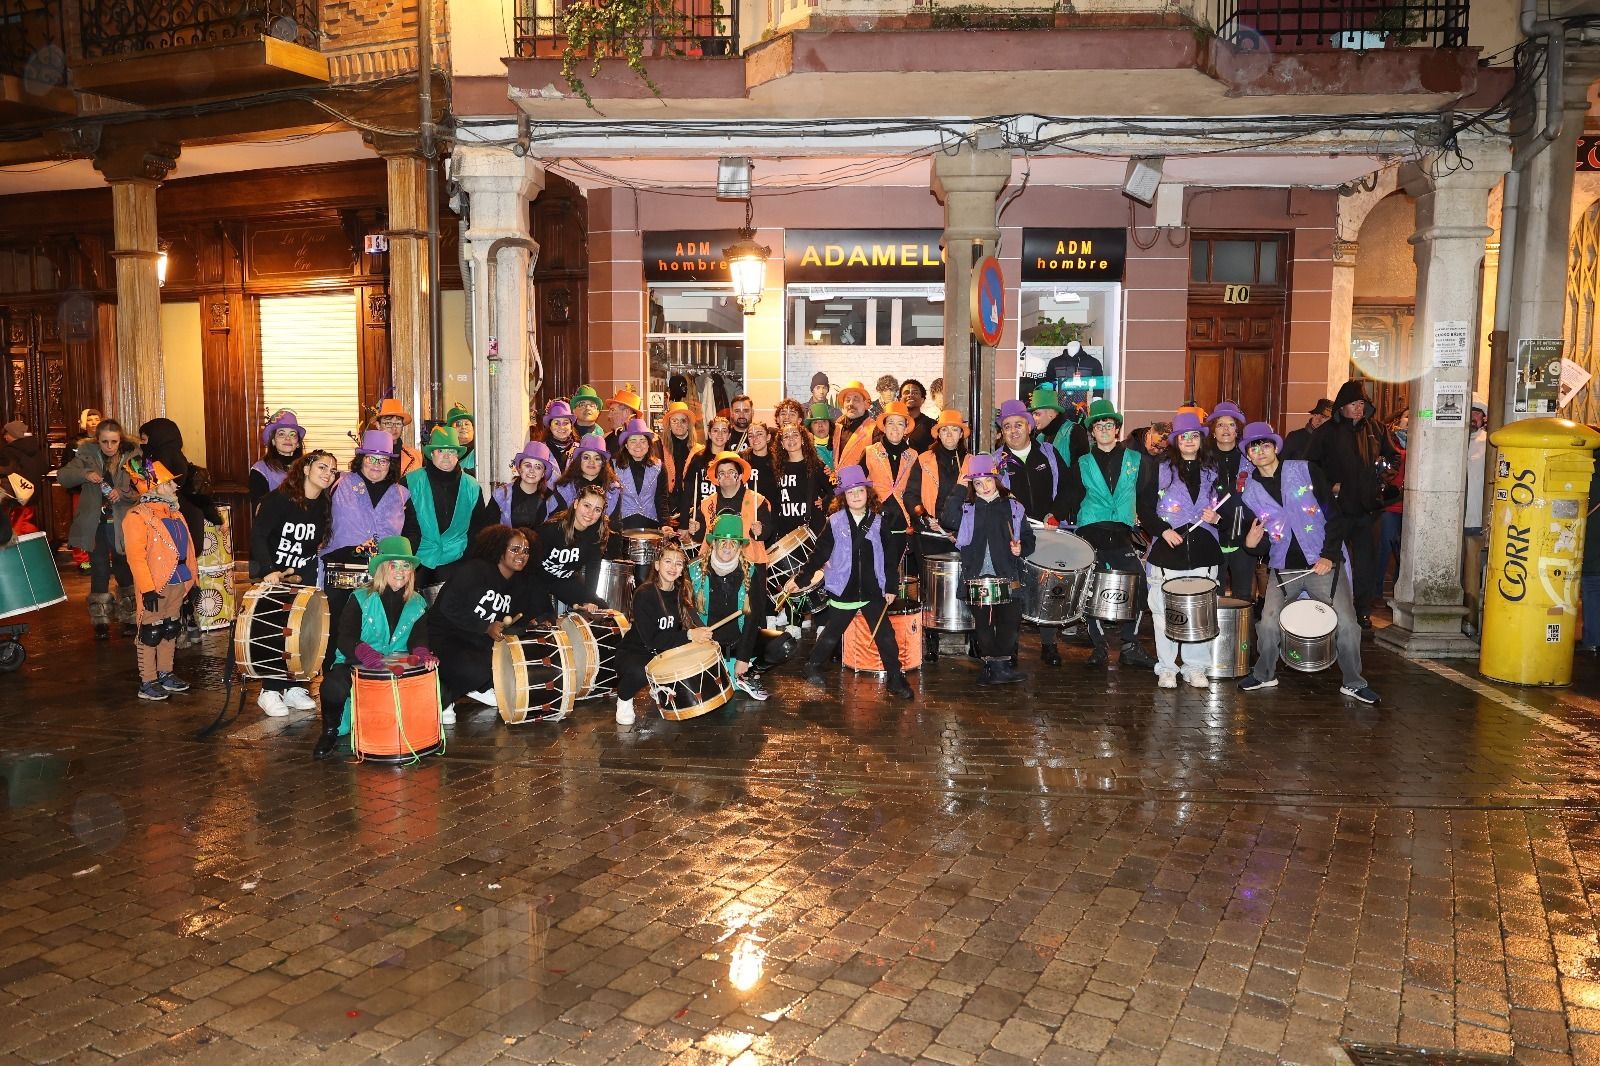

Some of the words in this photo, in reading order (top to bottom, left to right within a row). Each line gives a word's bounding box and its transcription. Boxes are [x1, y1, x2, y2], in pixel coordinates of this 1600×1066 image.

[675, 241, 710, 256] ADM
[1055, 240, 1092, 255] ADM
[800, 244, 945, 267] ADAMEL
[658, 258, 729, 271] hombre
[1037, 257, 1108, 270] hombre
[1226, 286, 1249, 302] 10
[779, 502, 807, 517] UKA
[281, 521, 316, 541] POR
[1498, 469, 1536, 602] CORROS
[277, 536, 303, 555] BA
[548, 547, 580, 564] POR
[478, 589, 512, 614] POR
[1103, 591, 1127, 602] OZZI
[657, 615, 675, 630] OR
